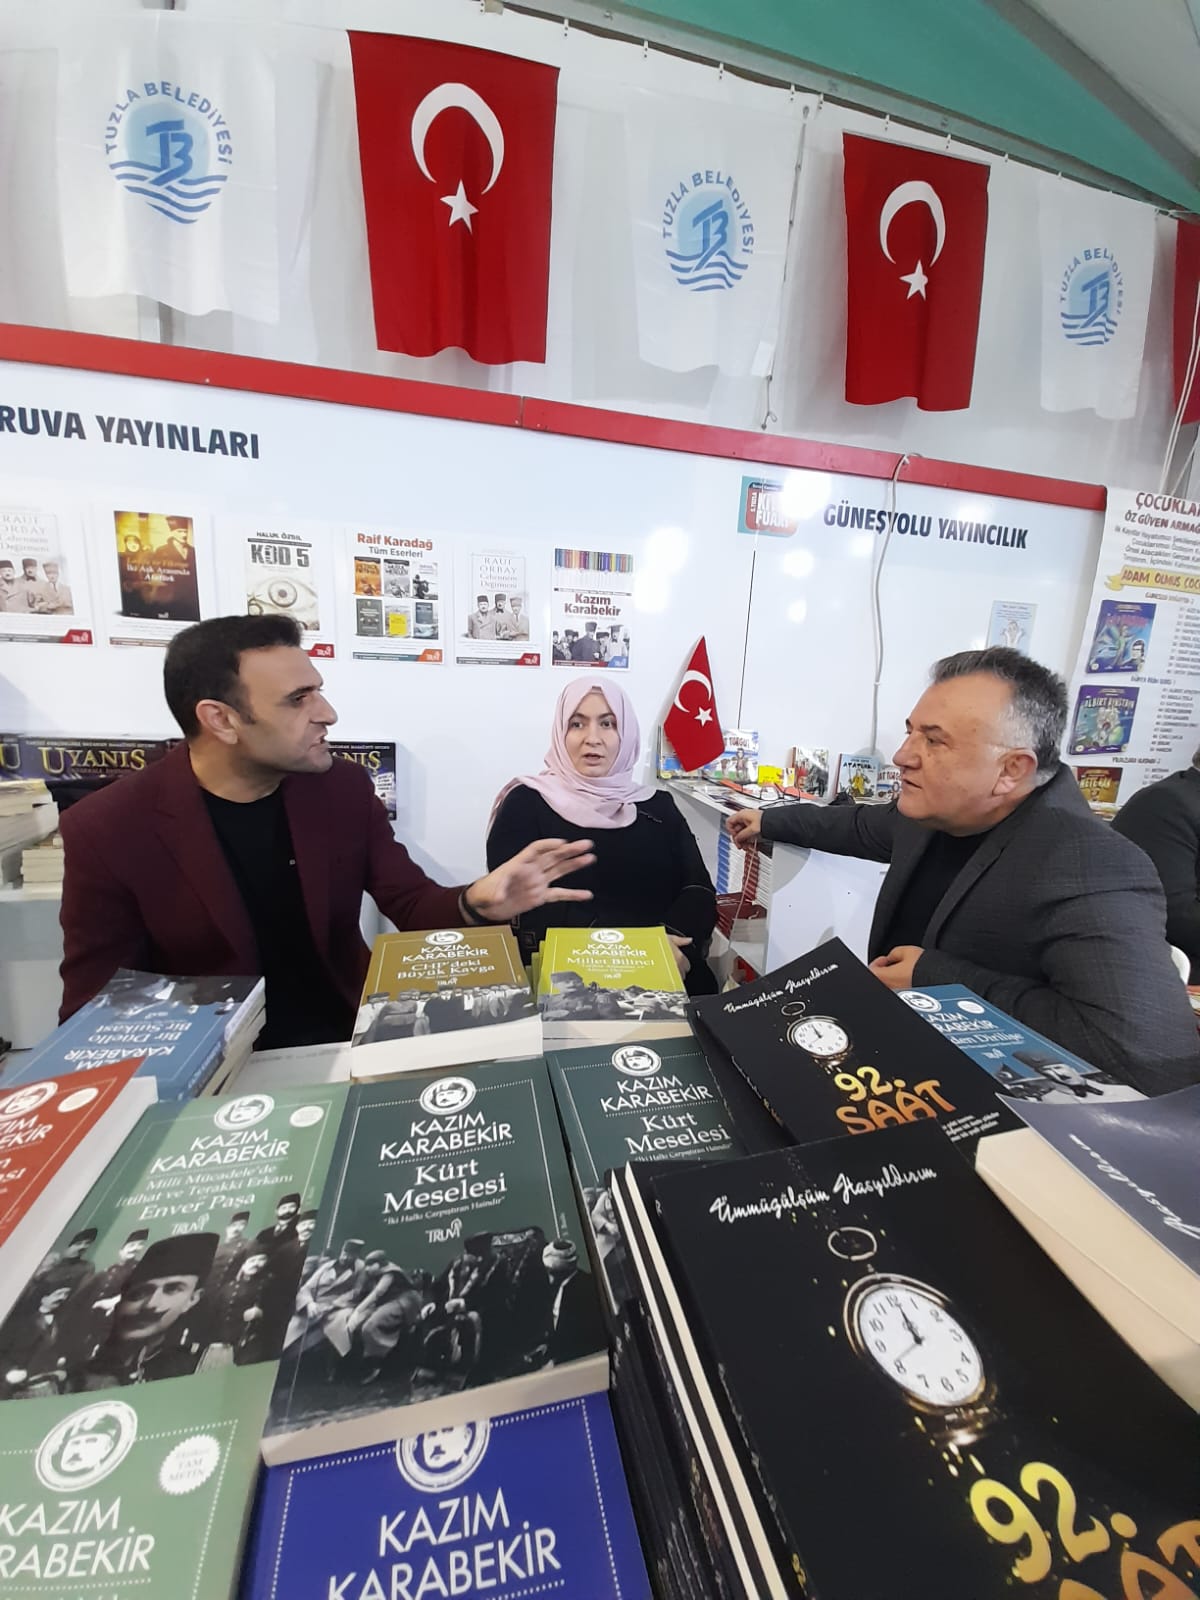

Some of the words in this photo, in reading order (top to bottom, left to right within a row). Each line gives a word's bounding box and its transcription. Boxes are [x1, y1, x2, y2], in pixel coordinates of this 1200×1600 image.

[105, 89, 141, 155] TUZLA
[662, 181, 690, 239] TUZLA
[95, 414, 260, 460] YAYINLARI
[823, 499, 933, 538] GÜNEŞYOLU
[938, 517, 1029, 550] YAYINCILIK
[1138, 513, 1169, 529] GÜVEN
[357, 533, 382, 546] Raif
[384, 535, 434, 550] Karadağ
[368, 546, 388, 556] Tüm
[389, 548, 424, 559] Eserleri
[251, 543, 291, 566] KOD
[296, 547, 309, 568] 5
[1121, 569, 1151, 584] ADAM
[564, 602, 622, 617] Karabekir
[574, 592, 611, 606] Kazım
[402, 948, 489, 963] KARABEKİR
[420, 943, 472, 954] KAZIM
[572, 948, 648, 957] KARABEKİR
[587, 943, 632, 951] KAZIM
[397, 968, 445, 980] Büyük
[449, 964, 496, 975] Kavga
[566, 957, 608, 966] Millet
[611, 957, 655, 966] Bilinci
[616, 1074, 683, 1094] KAZIM
[600, 1083, 714, 1112] KARABEKİR
[410, 1111, 485, 1138] KAZIM
[640, 1111, 698, 1132] Kürt
[190, 1128, 270, 1151] KAZIM
[379, 1121, 514, 1161] KARABEKİR
[624, 1123, 732, 1154] Meselesi
[150, 1138, 291, 1175] KARABEKİR
[414, 1158, 479, 1186] Kürt
[166, 1190, 185, 1200] ve
[381, 1172, 508, 1214] Meselesi
[138, 1200, 207, 1221] Enver
[208, 1192, 256, 1211] Paşa
[0, 1496, 121, 1537] KAZIM
[378, 1486, 511, 1558] KAZIM
[327, 1520, 563, 1600] KARABEKİR
